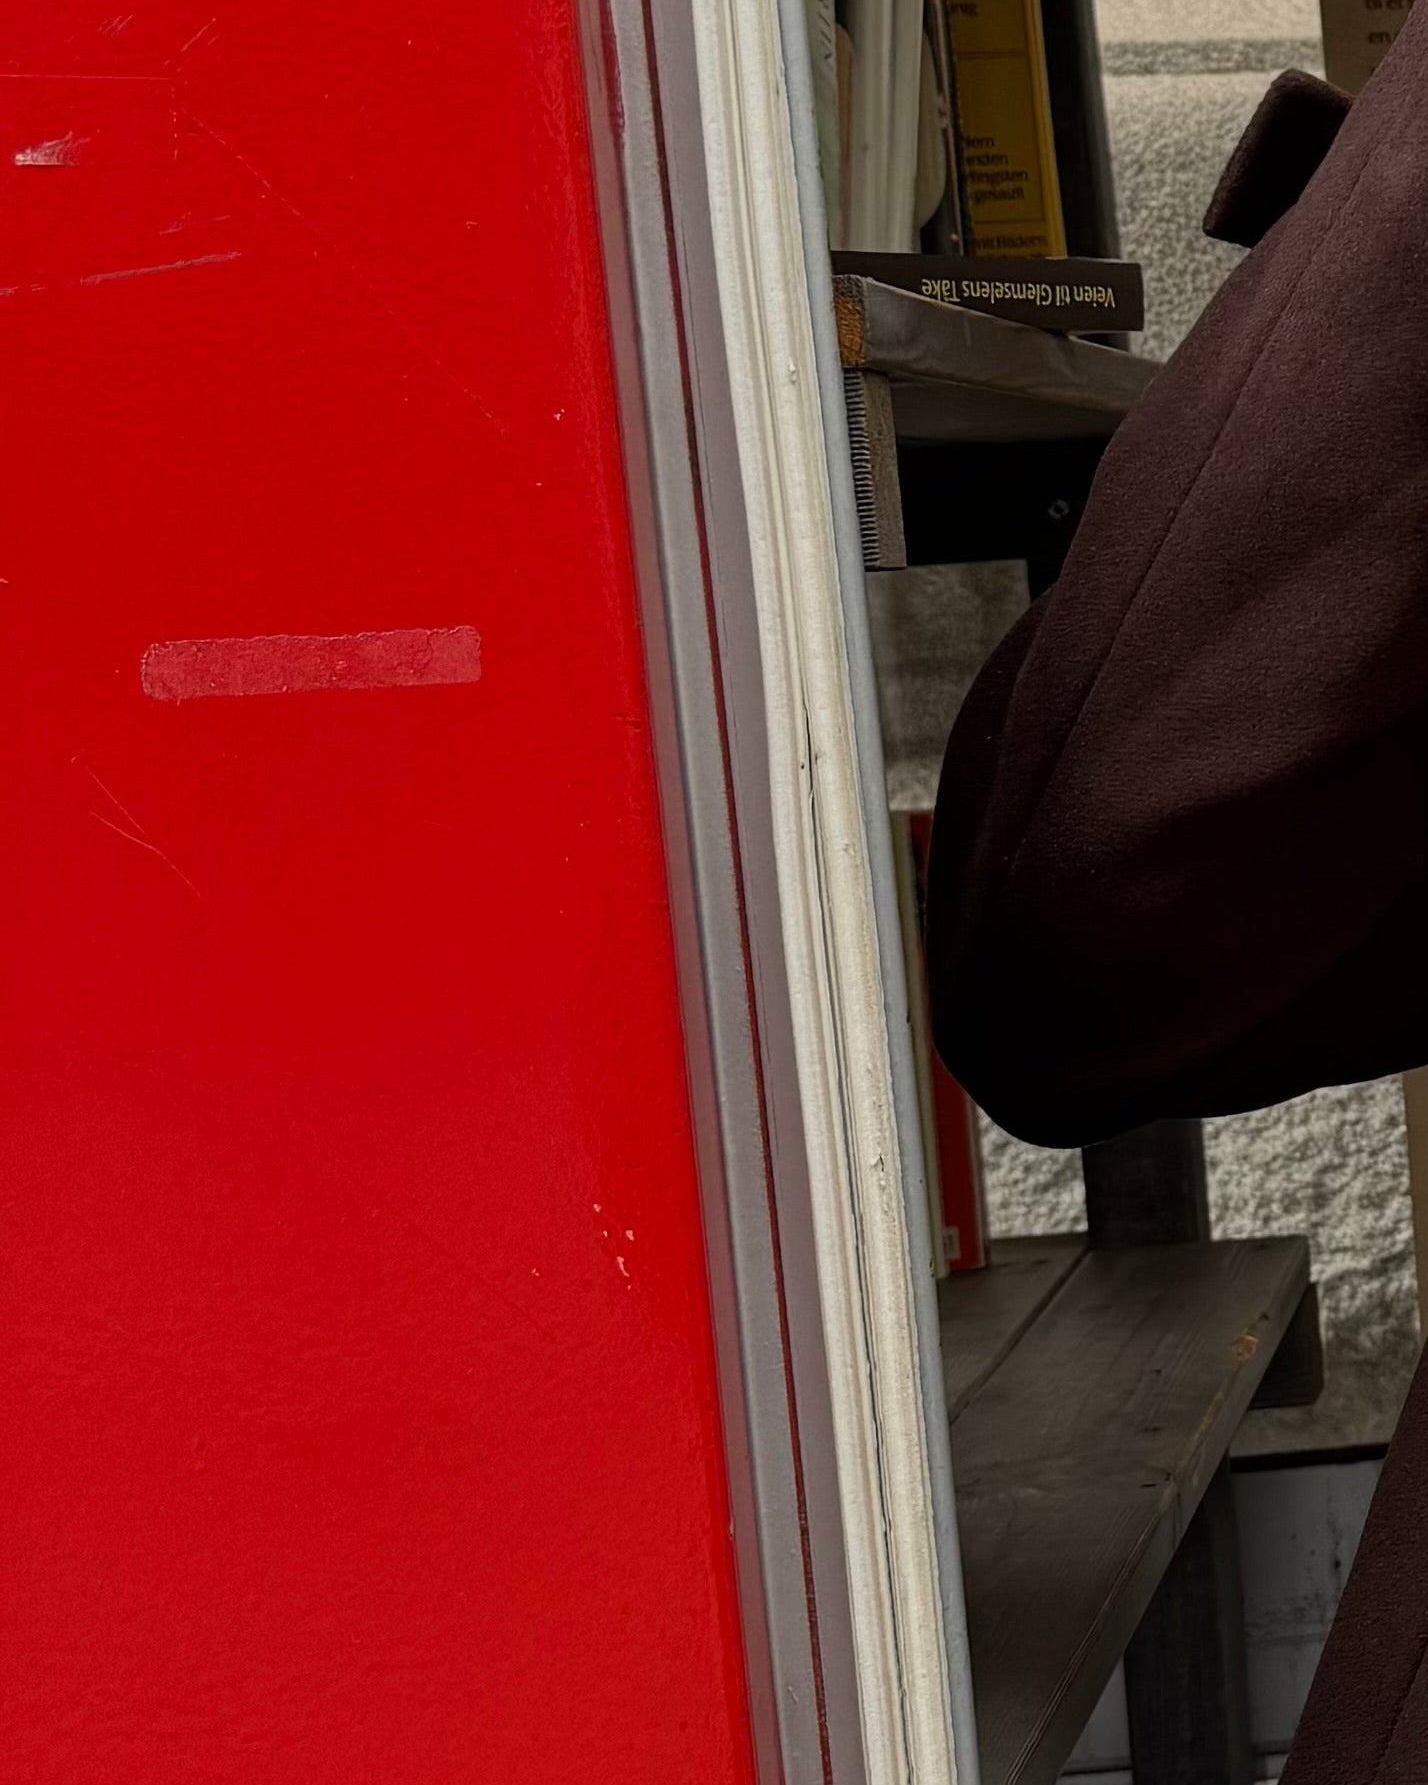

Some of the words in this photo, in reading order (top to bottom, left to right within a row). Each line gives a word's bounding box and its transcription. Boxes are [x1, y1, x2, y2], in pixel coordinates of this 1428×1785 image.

[921, 278, 960, 302] Tåke
[961, 281, 1053, 306] Glemselens
[1056, 285, 1070, 307] til
[1074, 285, 1116, 308] Veien
